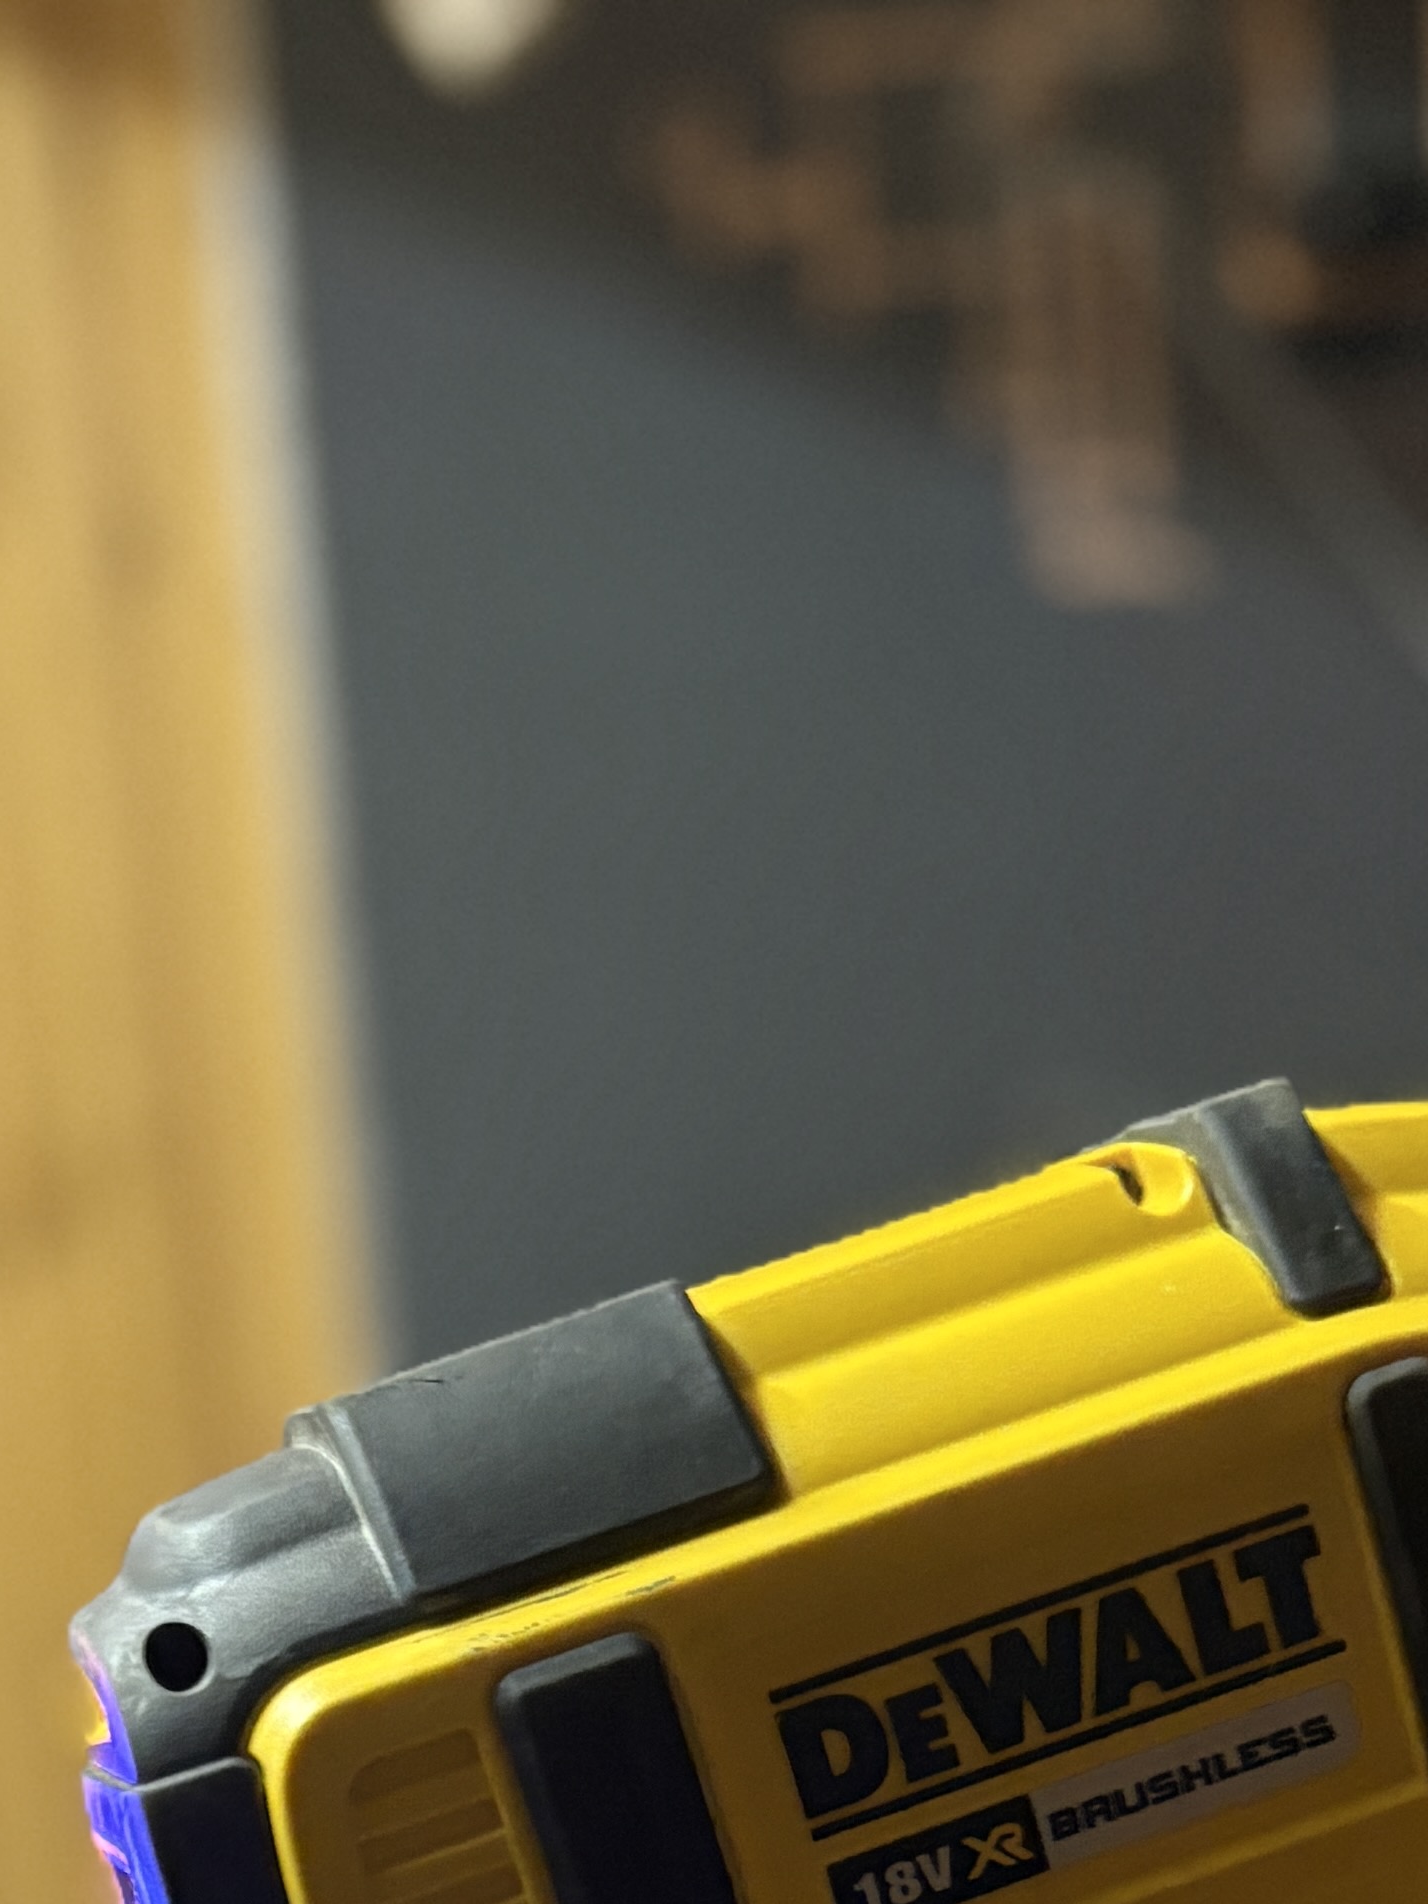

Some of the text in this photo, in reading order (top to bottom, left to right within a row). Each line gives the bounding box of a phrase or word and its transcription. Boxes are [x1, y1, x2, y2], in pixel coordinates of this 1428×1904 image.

[776, 1525, 1321, 1820] DEWALT
[964, 1820, 1035, 1881] XR
[1049, 1713, 1337, 1843] BRUSHLESS
